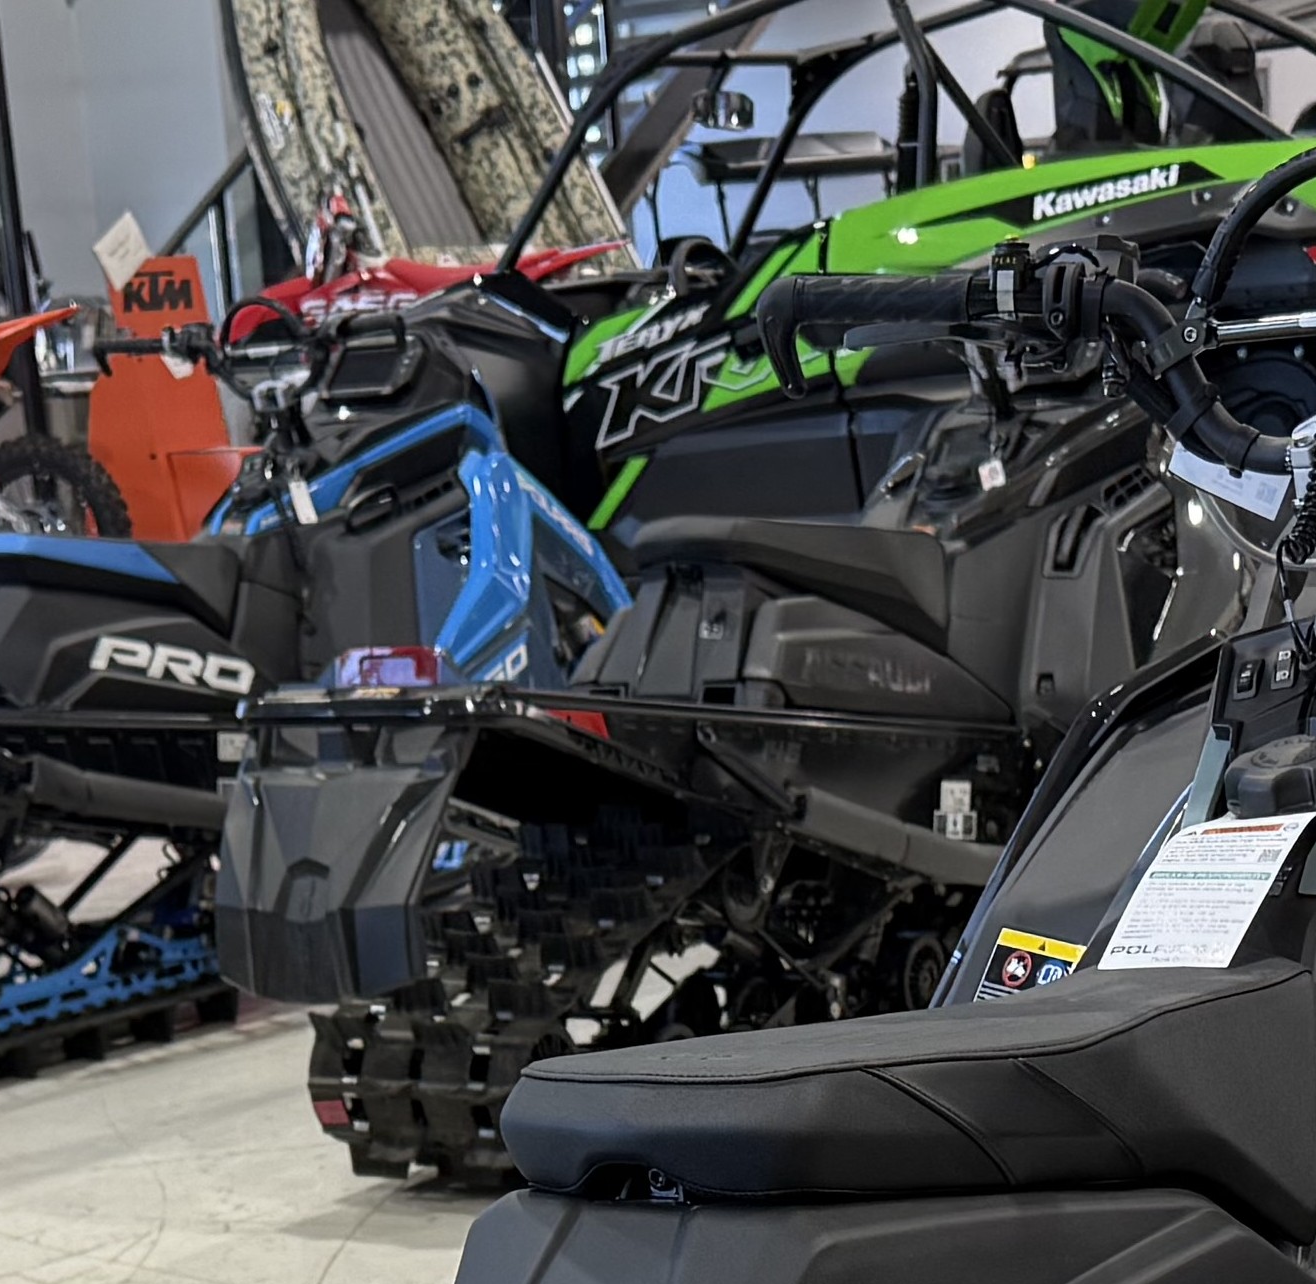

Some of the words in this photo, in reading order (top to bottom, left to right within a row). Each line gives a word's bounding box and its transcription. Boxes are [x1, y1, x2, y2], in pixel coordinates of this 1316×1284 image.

[1032, 163, 1180, 221] Kawasaki
[123, 271, 193, 313] KTM
[597, 302, 711, 363] TERYX
[89, 635, 256, 694] PRO
